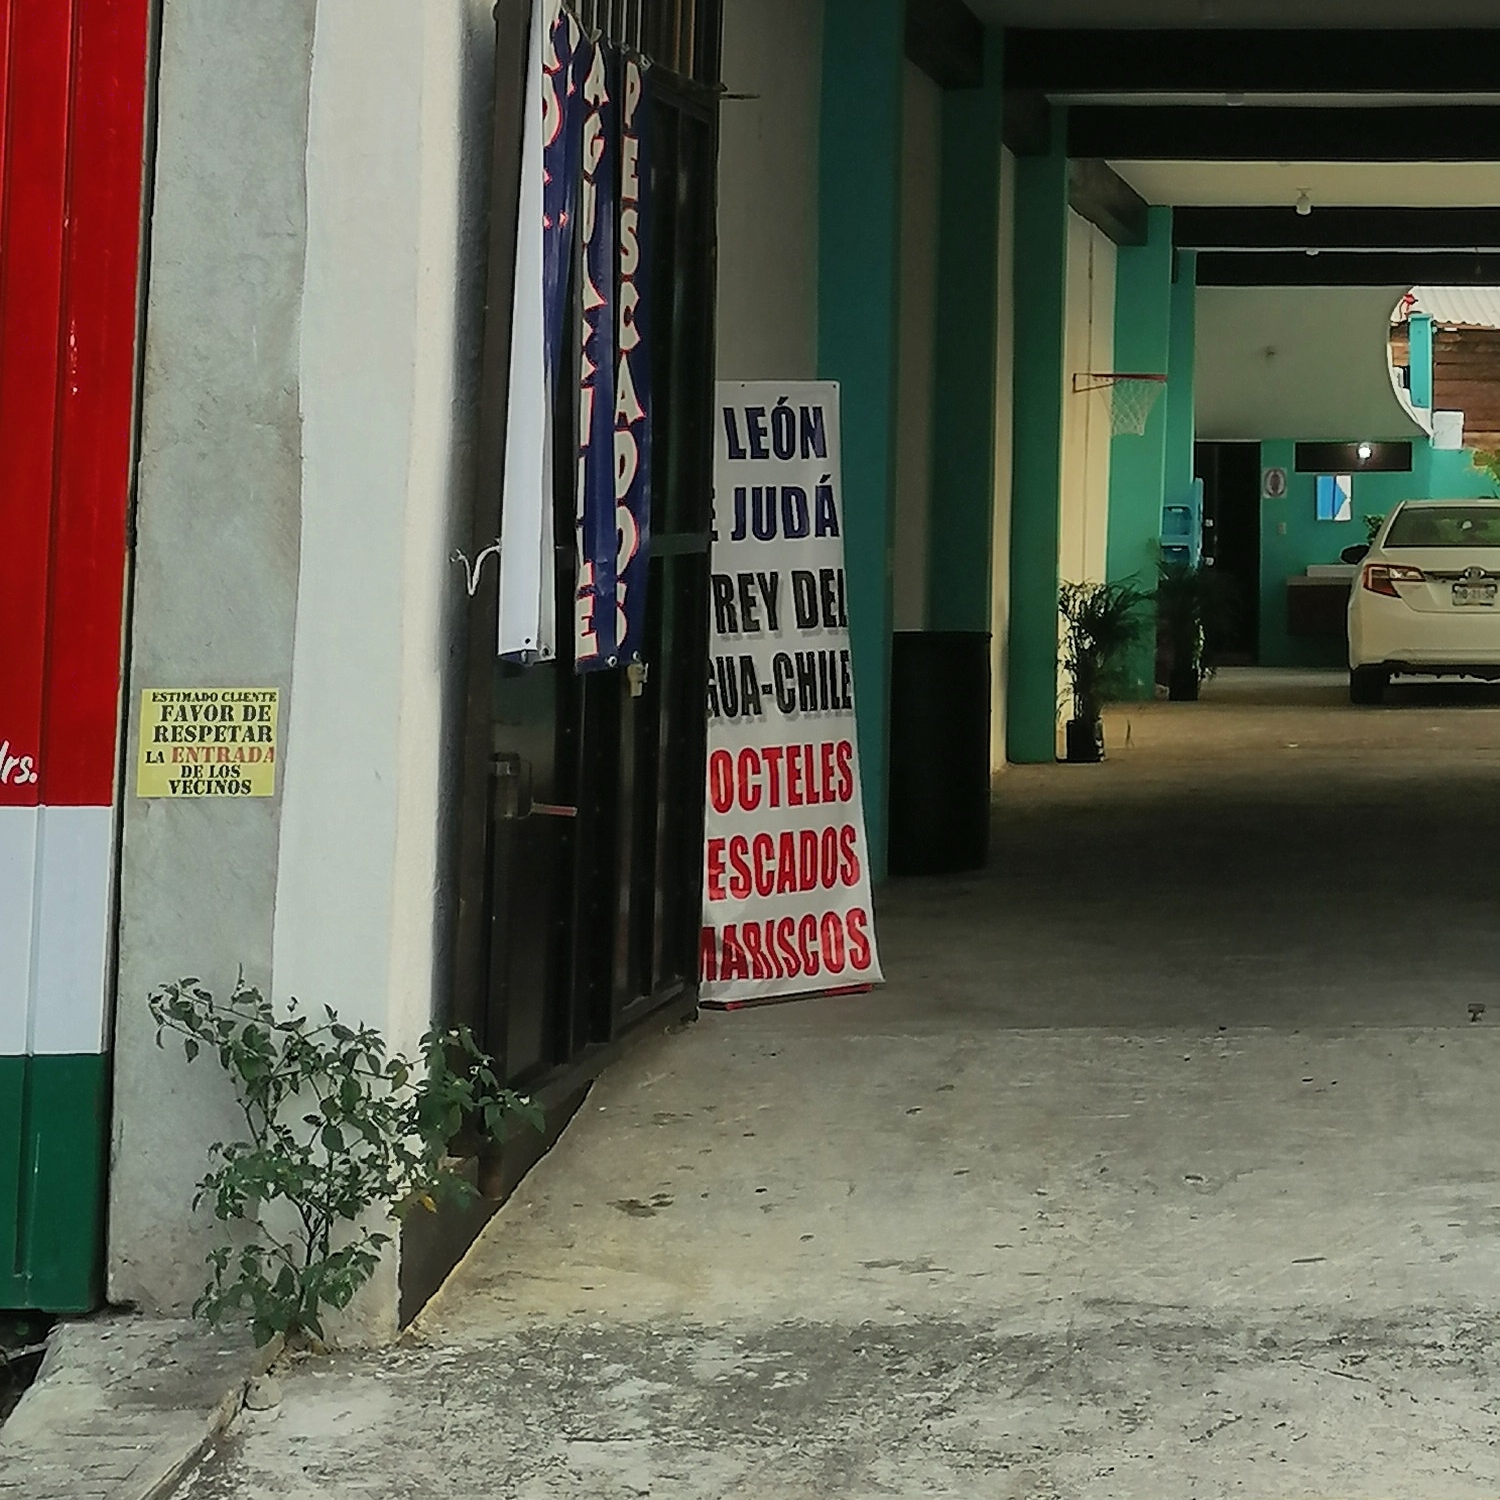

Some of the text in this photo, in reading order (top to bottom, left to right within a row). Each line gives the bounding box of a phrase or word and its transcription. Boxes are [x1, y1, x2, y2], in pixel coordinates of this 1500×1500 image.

[723, 397, 828, 461] LEÓN
[731, 474, 840, 541] JUDÁ
[711, 571, 779, 634] REY
[152, 691, 277, 703] ESTIMADO CLIENTE
[160, 704, 271, 722] FAVOR DE
[153, 725, 273, 743] RESPETAR
[145, 746, 275, 764] LA ENTRADA
[181, 764, 241, 779] DE LOS
[168, 779, 252, 795] VECINOS
